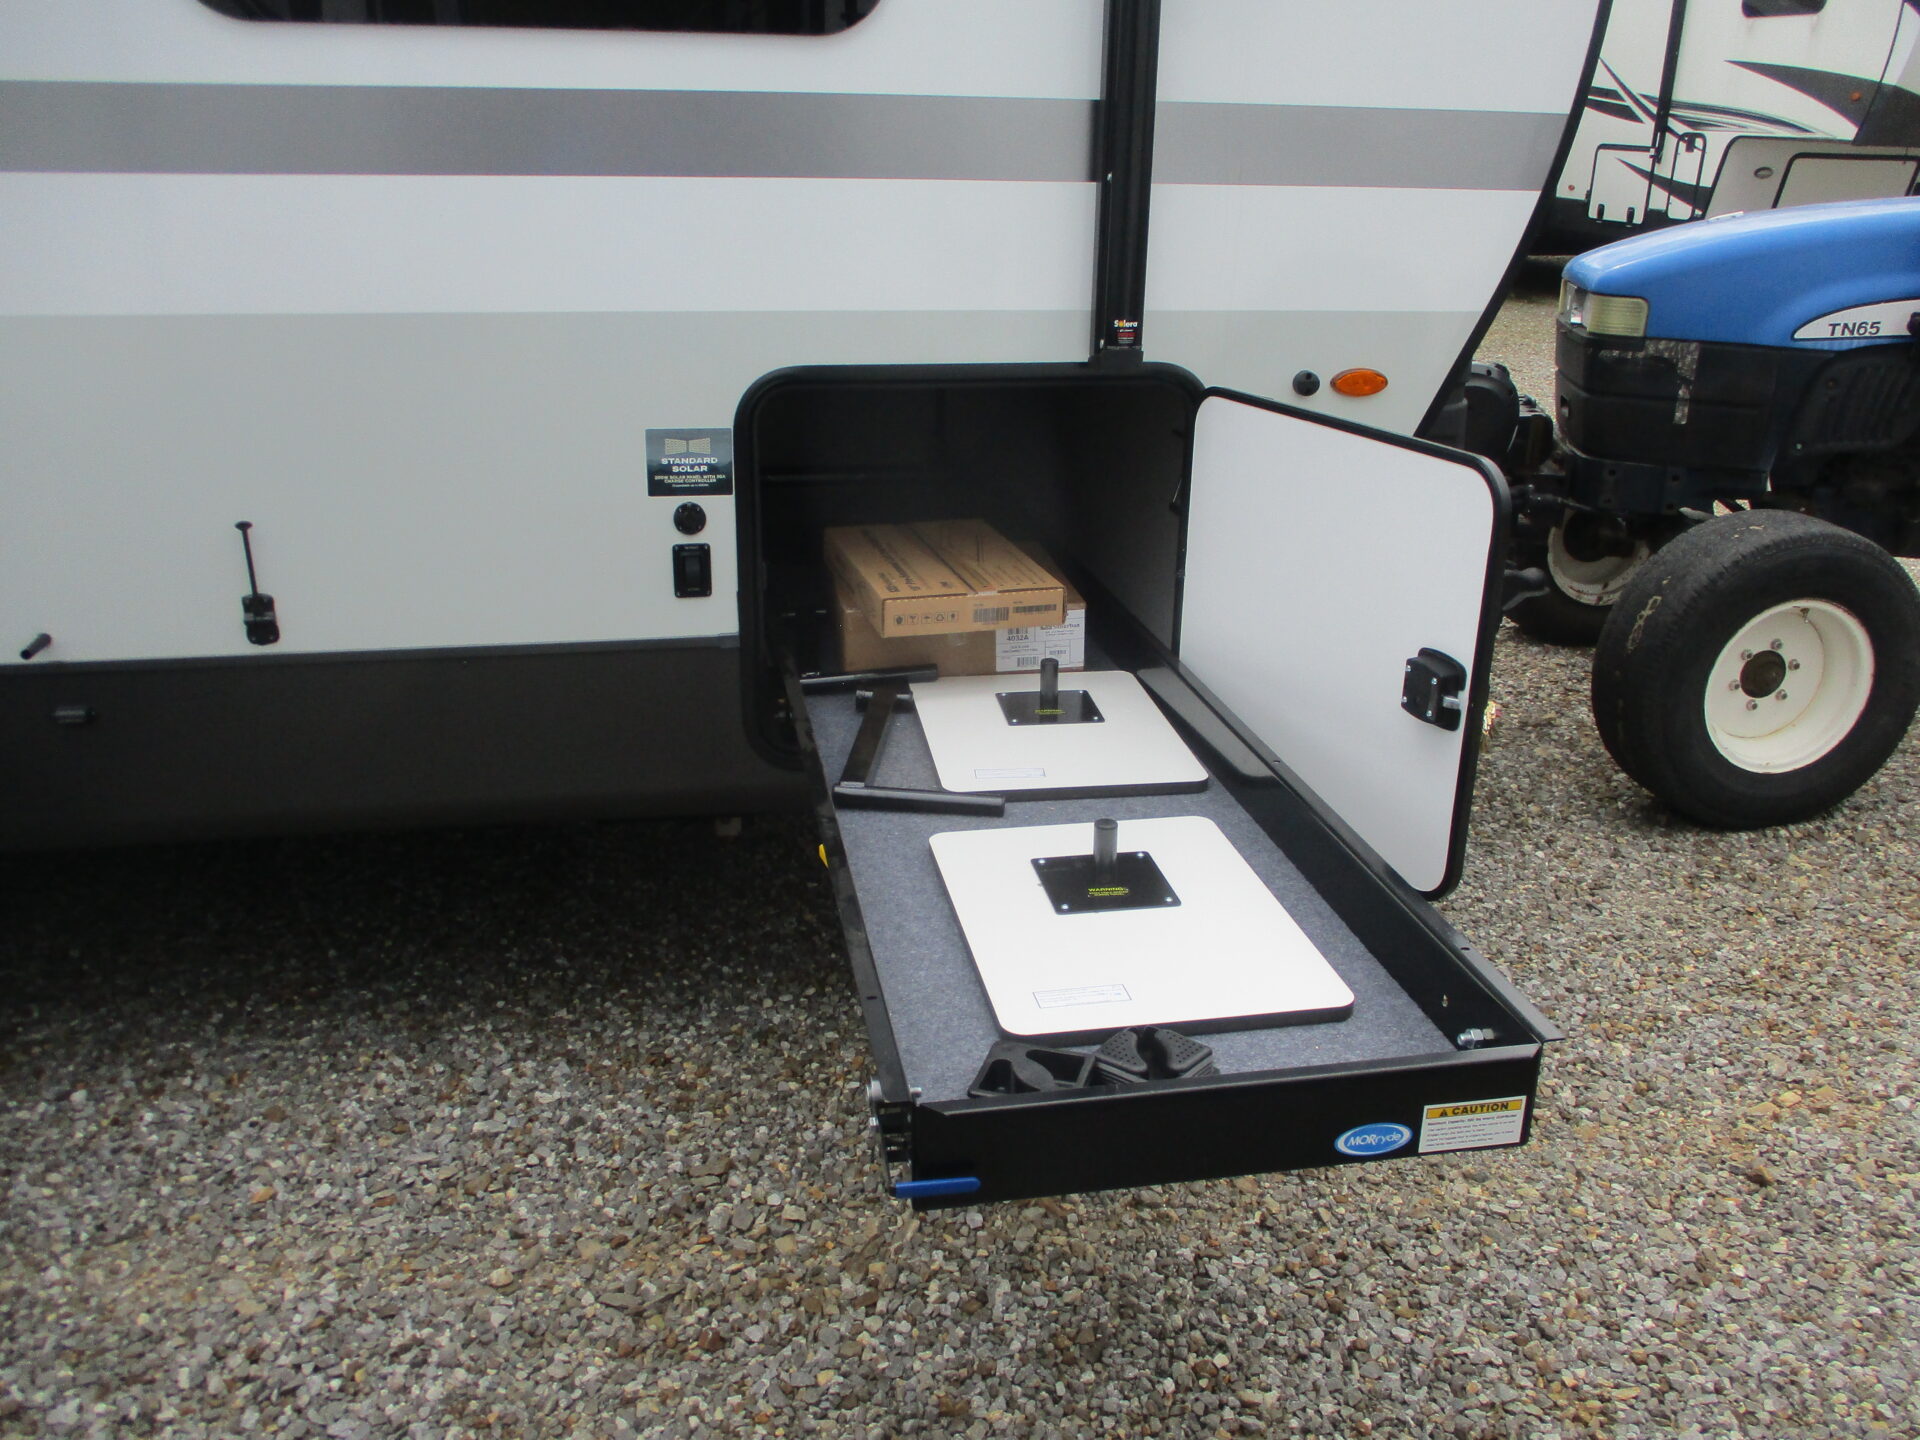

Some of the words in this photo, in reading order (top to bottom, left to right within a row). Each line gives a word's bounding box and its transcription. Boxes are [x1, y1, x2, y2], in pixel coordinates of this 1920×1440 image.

[1113, 319, 1138, 328] Solera
[1828, 321, 1881, 336] TN65
[1451, 1102, 1509, 1116] CAUTION
